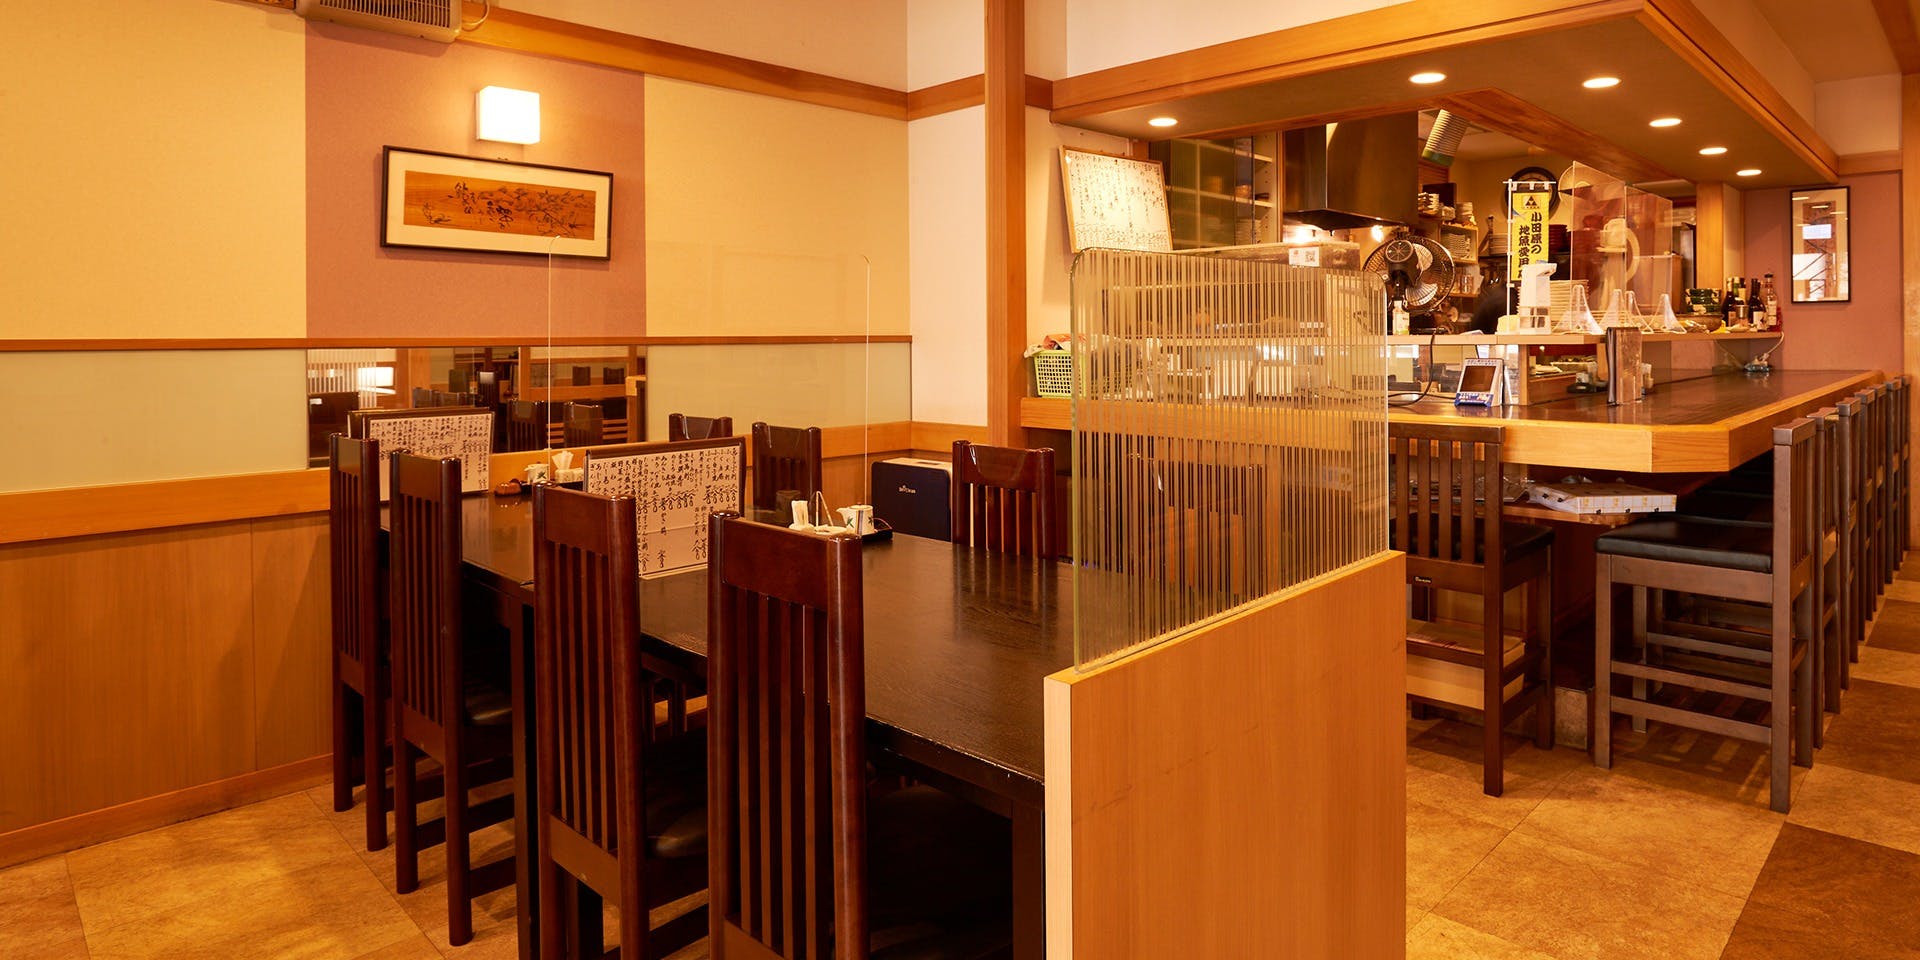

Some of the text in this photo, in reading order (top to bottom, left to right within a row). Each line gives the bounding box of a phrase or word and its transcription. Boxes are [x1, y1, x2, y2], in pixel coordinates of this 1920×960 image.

[1518, 225, 1531, 278] 地魚愛用
[1530, 211, 1542, 254] 小田原の
